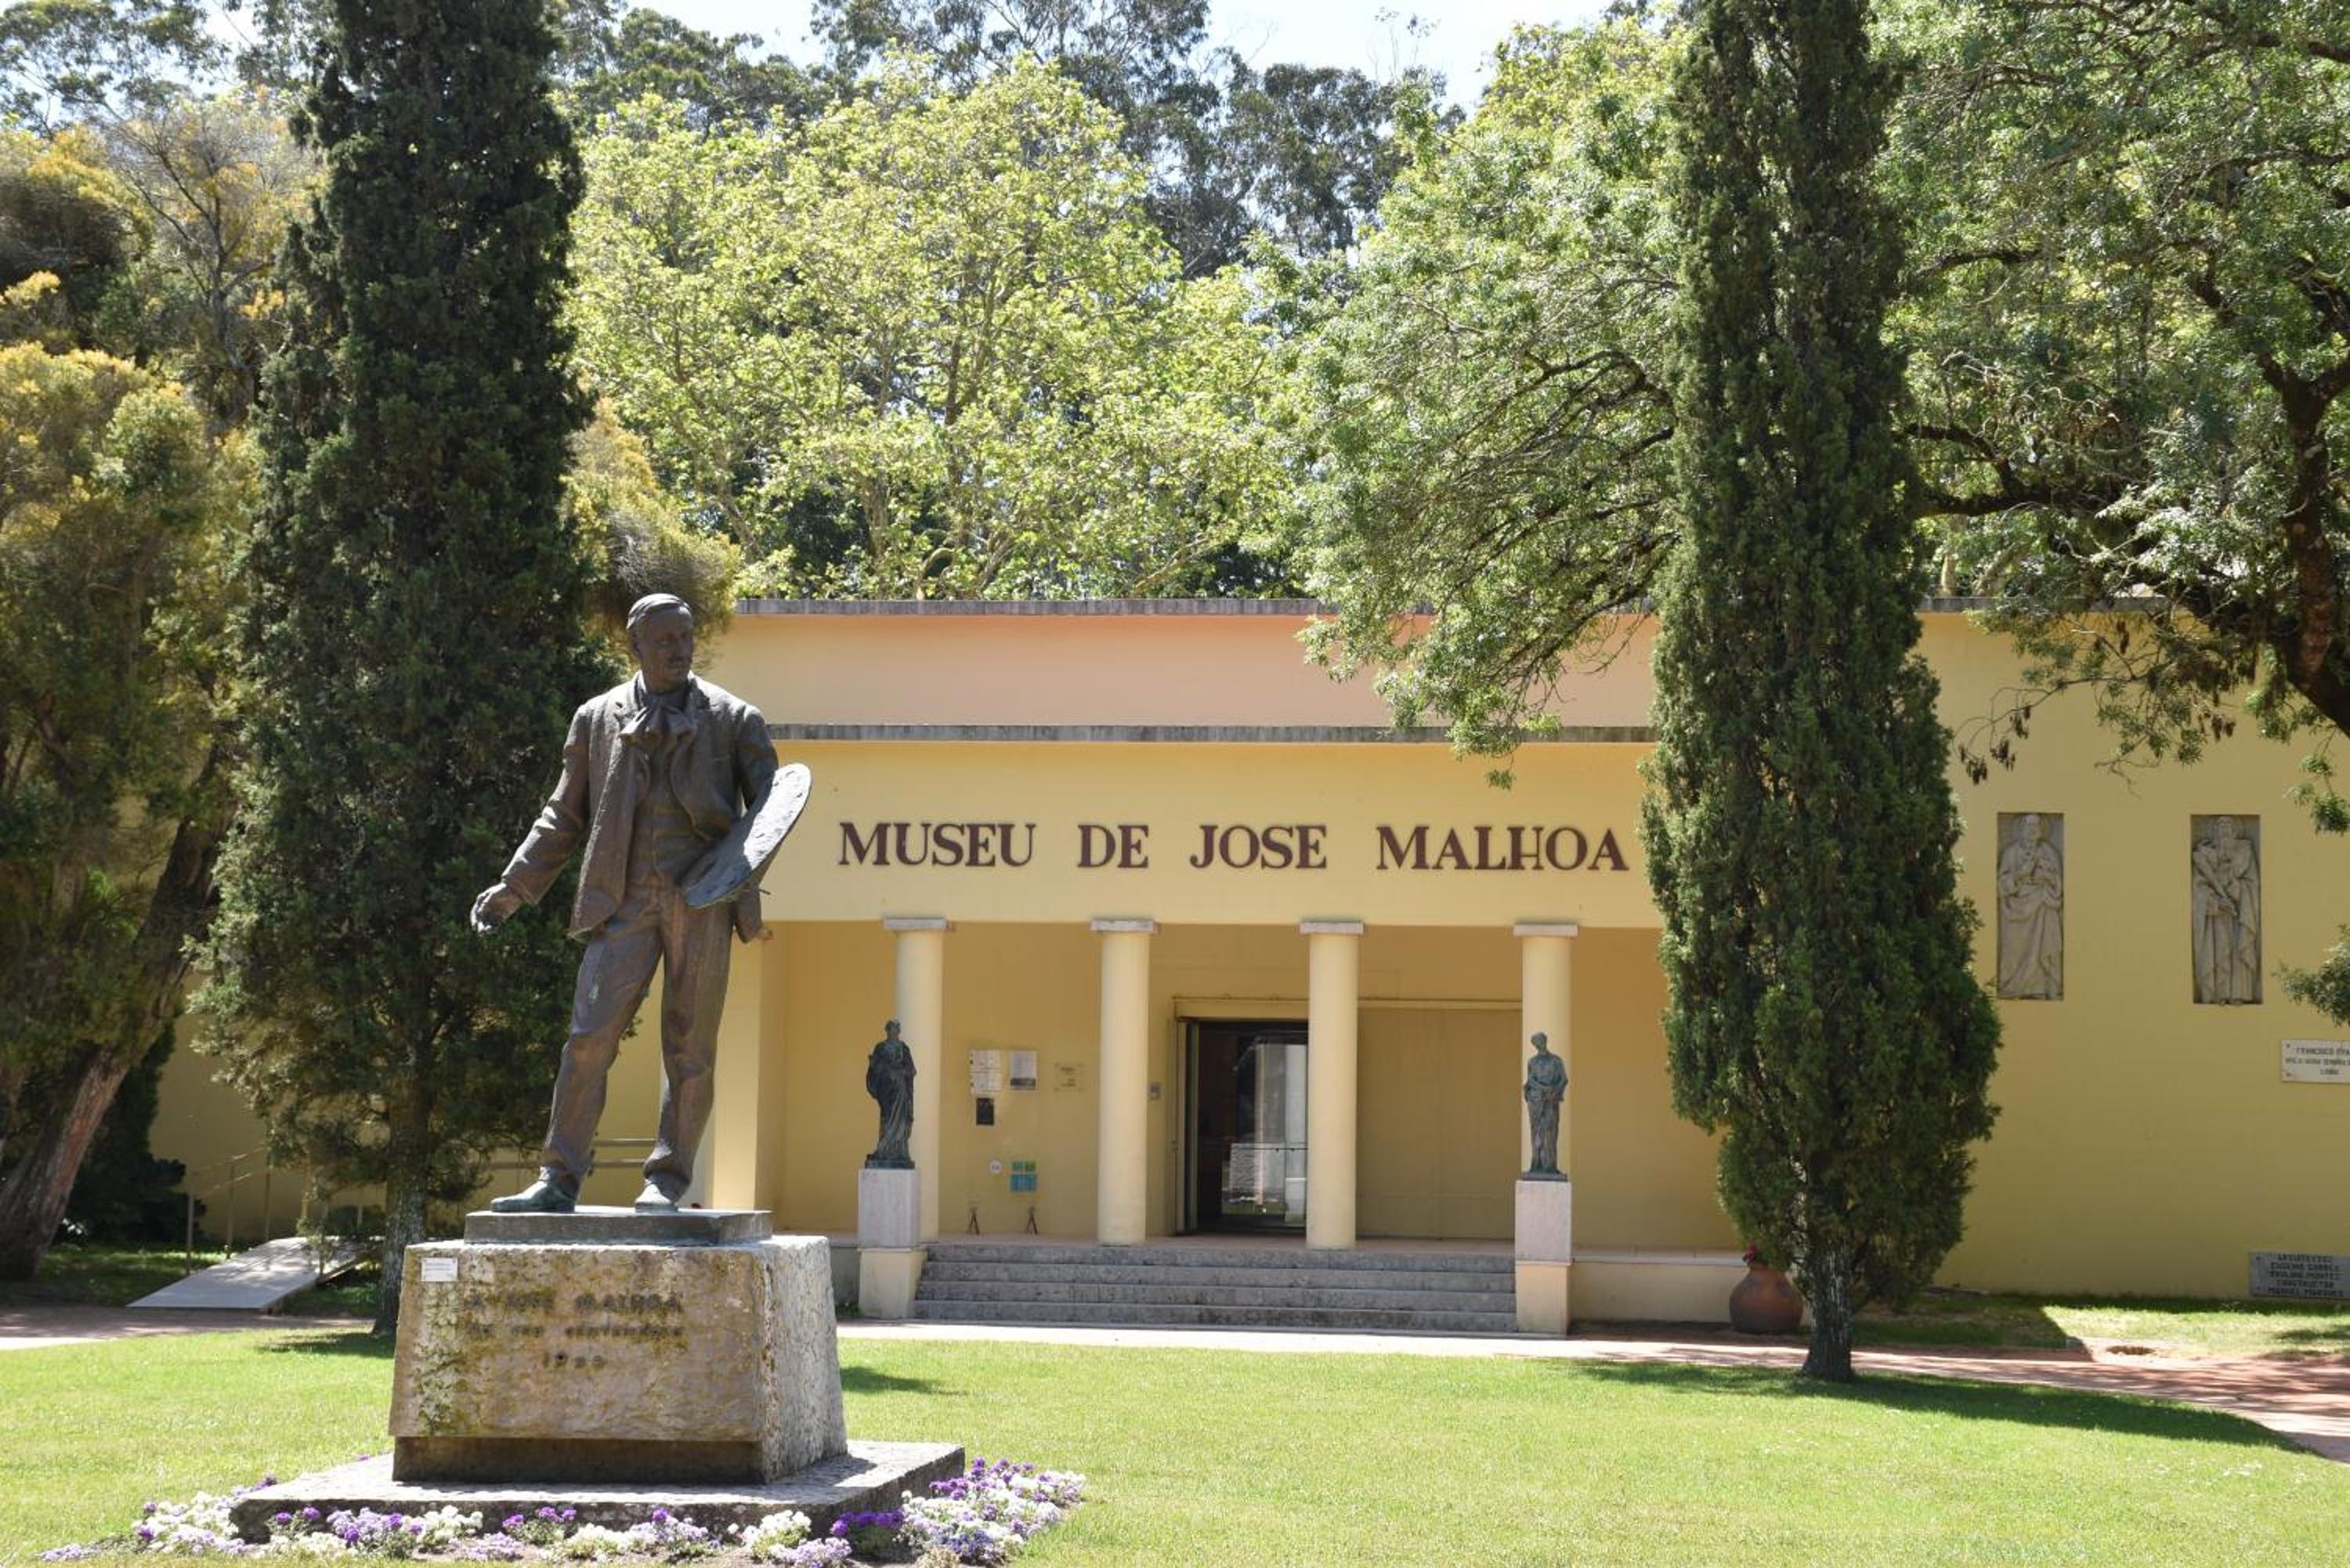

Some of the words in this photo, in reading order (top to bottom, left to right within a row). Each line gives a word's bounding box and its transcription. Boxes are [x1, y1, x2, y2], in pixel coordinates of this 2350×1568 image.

[837, 822, 1036, 868] MUSEU
[1077, 824, 1149, 869] DE
[1189, 825, 1327, 869] JOSE
[1376, 825, 1630, 872] MALHOA
